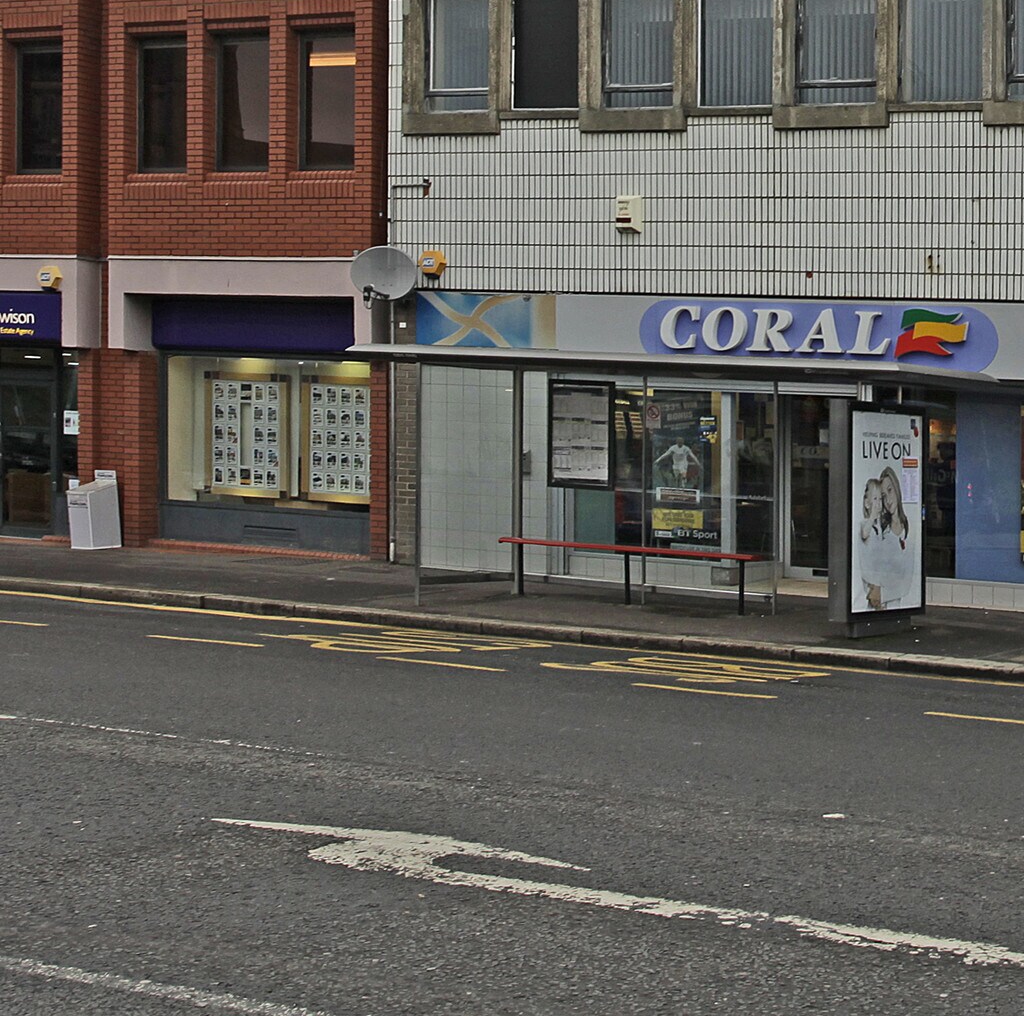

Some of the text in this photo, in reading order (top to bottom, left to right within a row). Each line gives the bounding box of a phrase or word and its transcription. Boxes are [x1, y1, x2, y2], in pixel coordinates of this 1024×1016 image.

[16, 327, 34, 336] Agency
[659, 305, 891, 356] CORAL
[862, 440, 912, 461] LIVE ON
[677, 529, 718, 540] BT Sport
